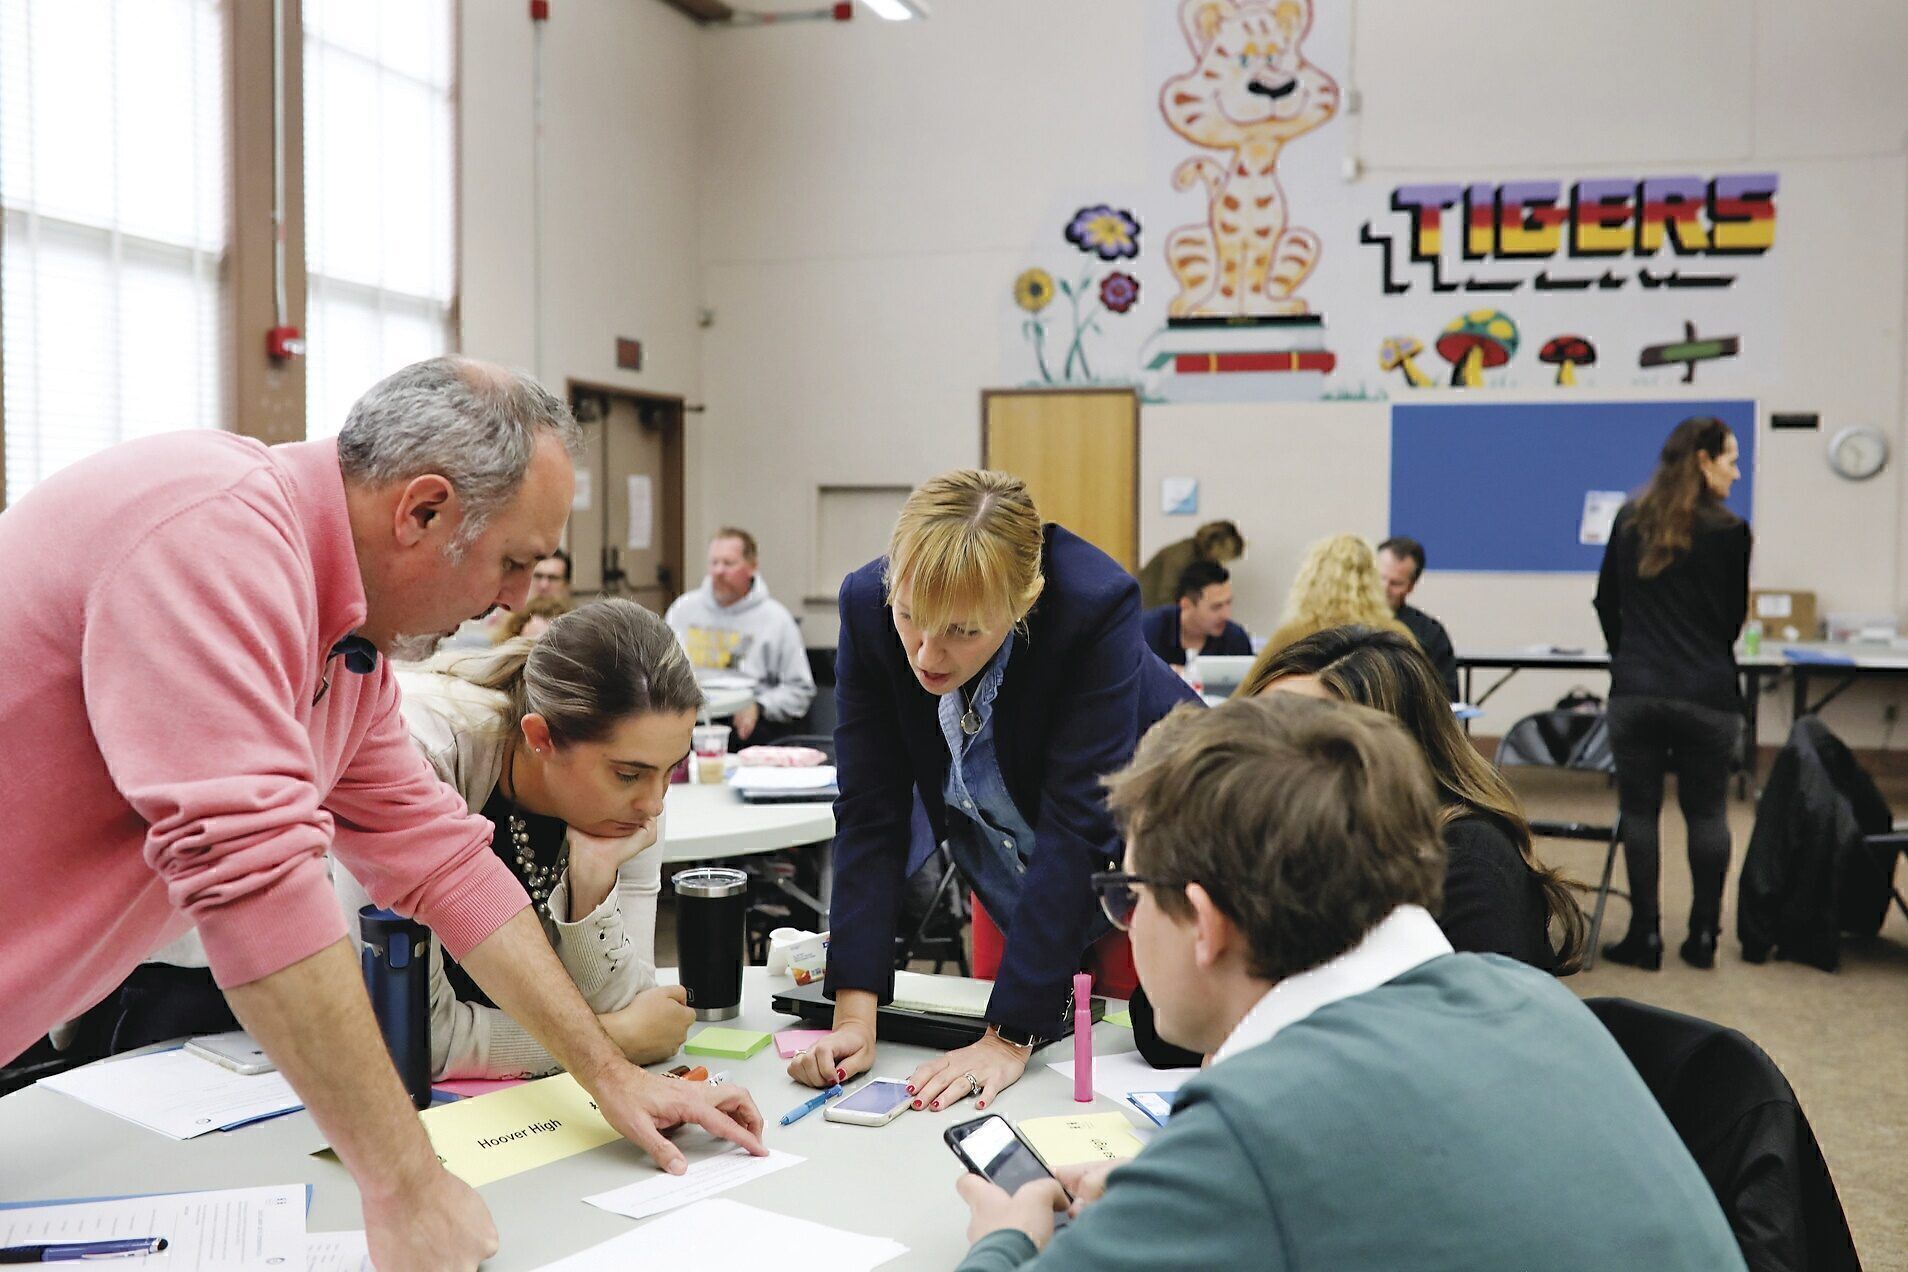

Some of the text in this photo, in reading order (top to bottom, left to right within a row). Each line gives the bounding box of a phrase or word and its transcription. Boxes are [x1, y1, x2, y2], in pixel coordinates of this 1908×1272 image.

[1391, 173, 1779, 260] TIGERS
[477, 1119, 562, 1149] Hoover High
